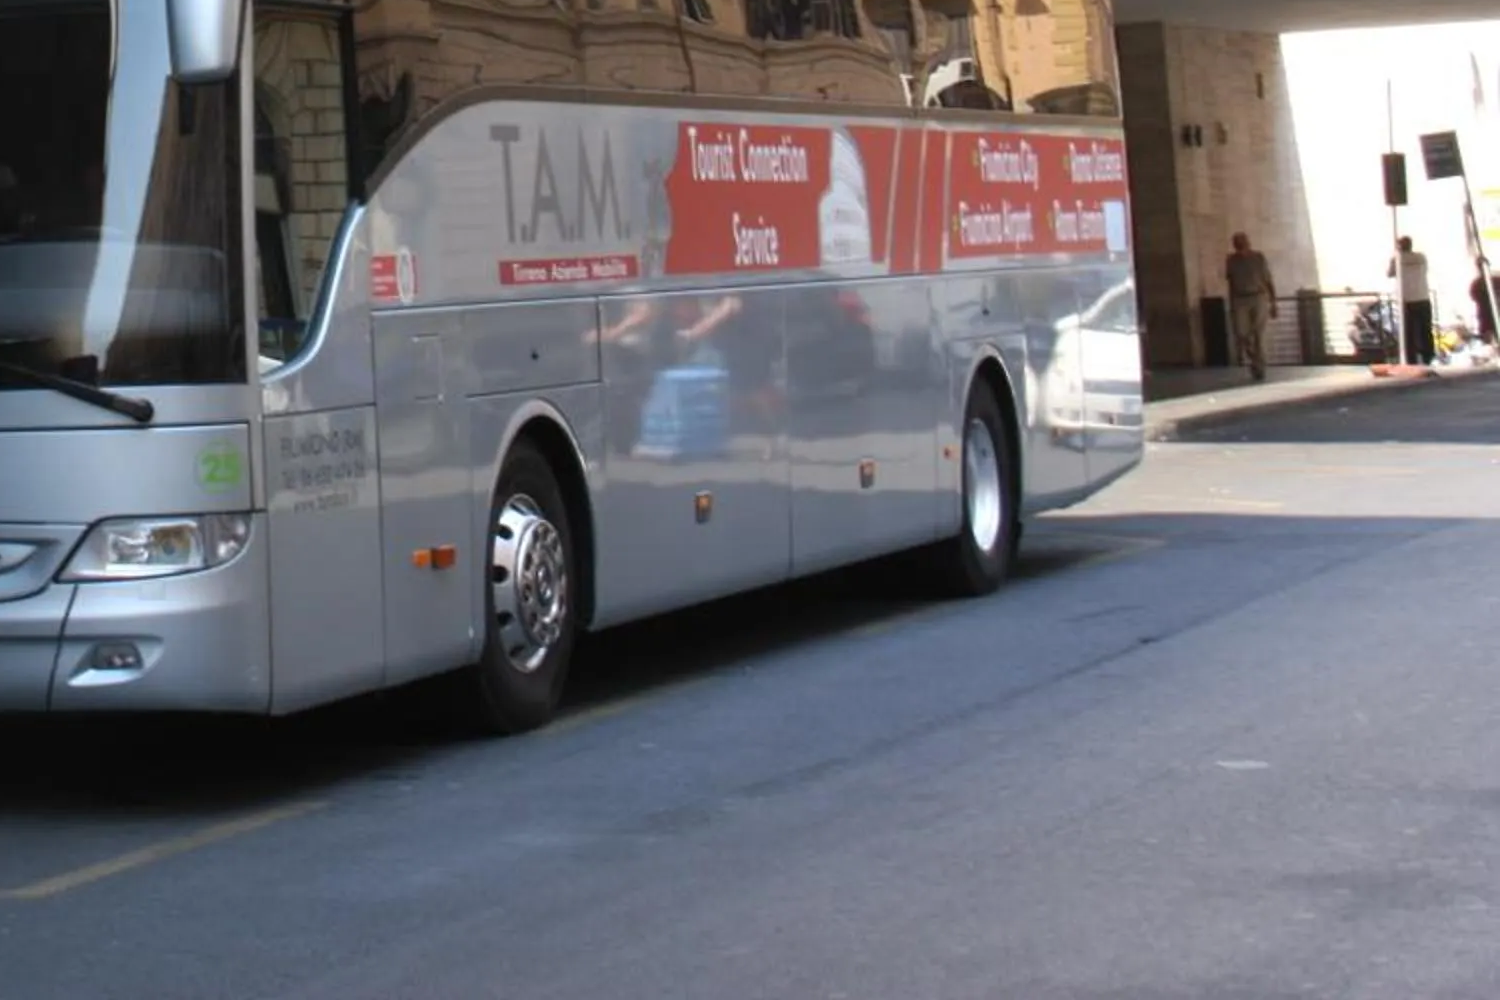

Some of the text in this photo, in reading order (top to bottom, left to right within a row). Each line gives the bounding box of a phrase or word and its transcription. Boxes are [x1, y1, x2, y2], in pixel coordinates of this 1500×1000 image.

[687, 125, 809, 183] Tourist Connection
[489, 123, 631, 244] T.A.M.
[732, 212, 780, 266] Service
